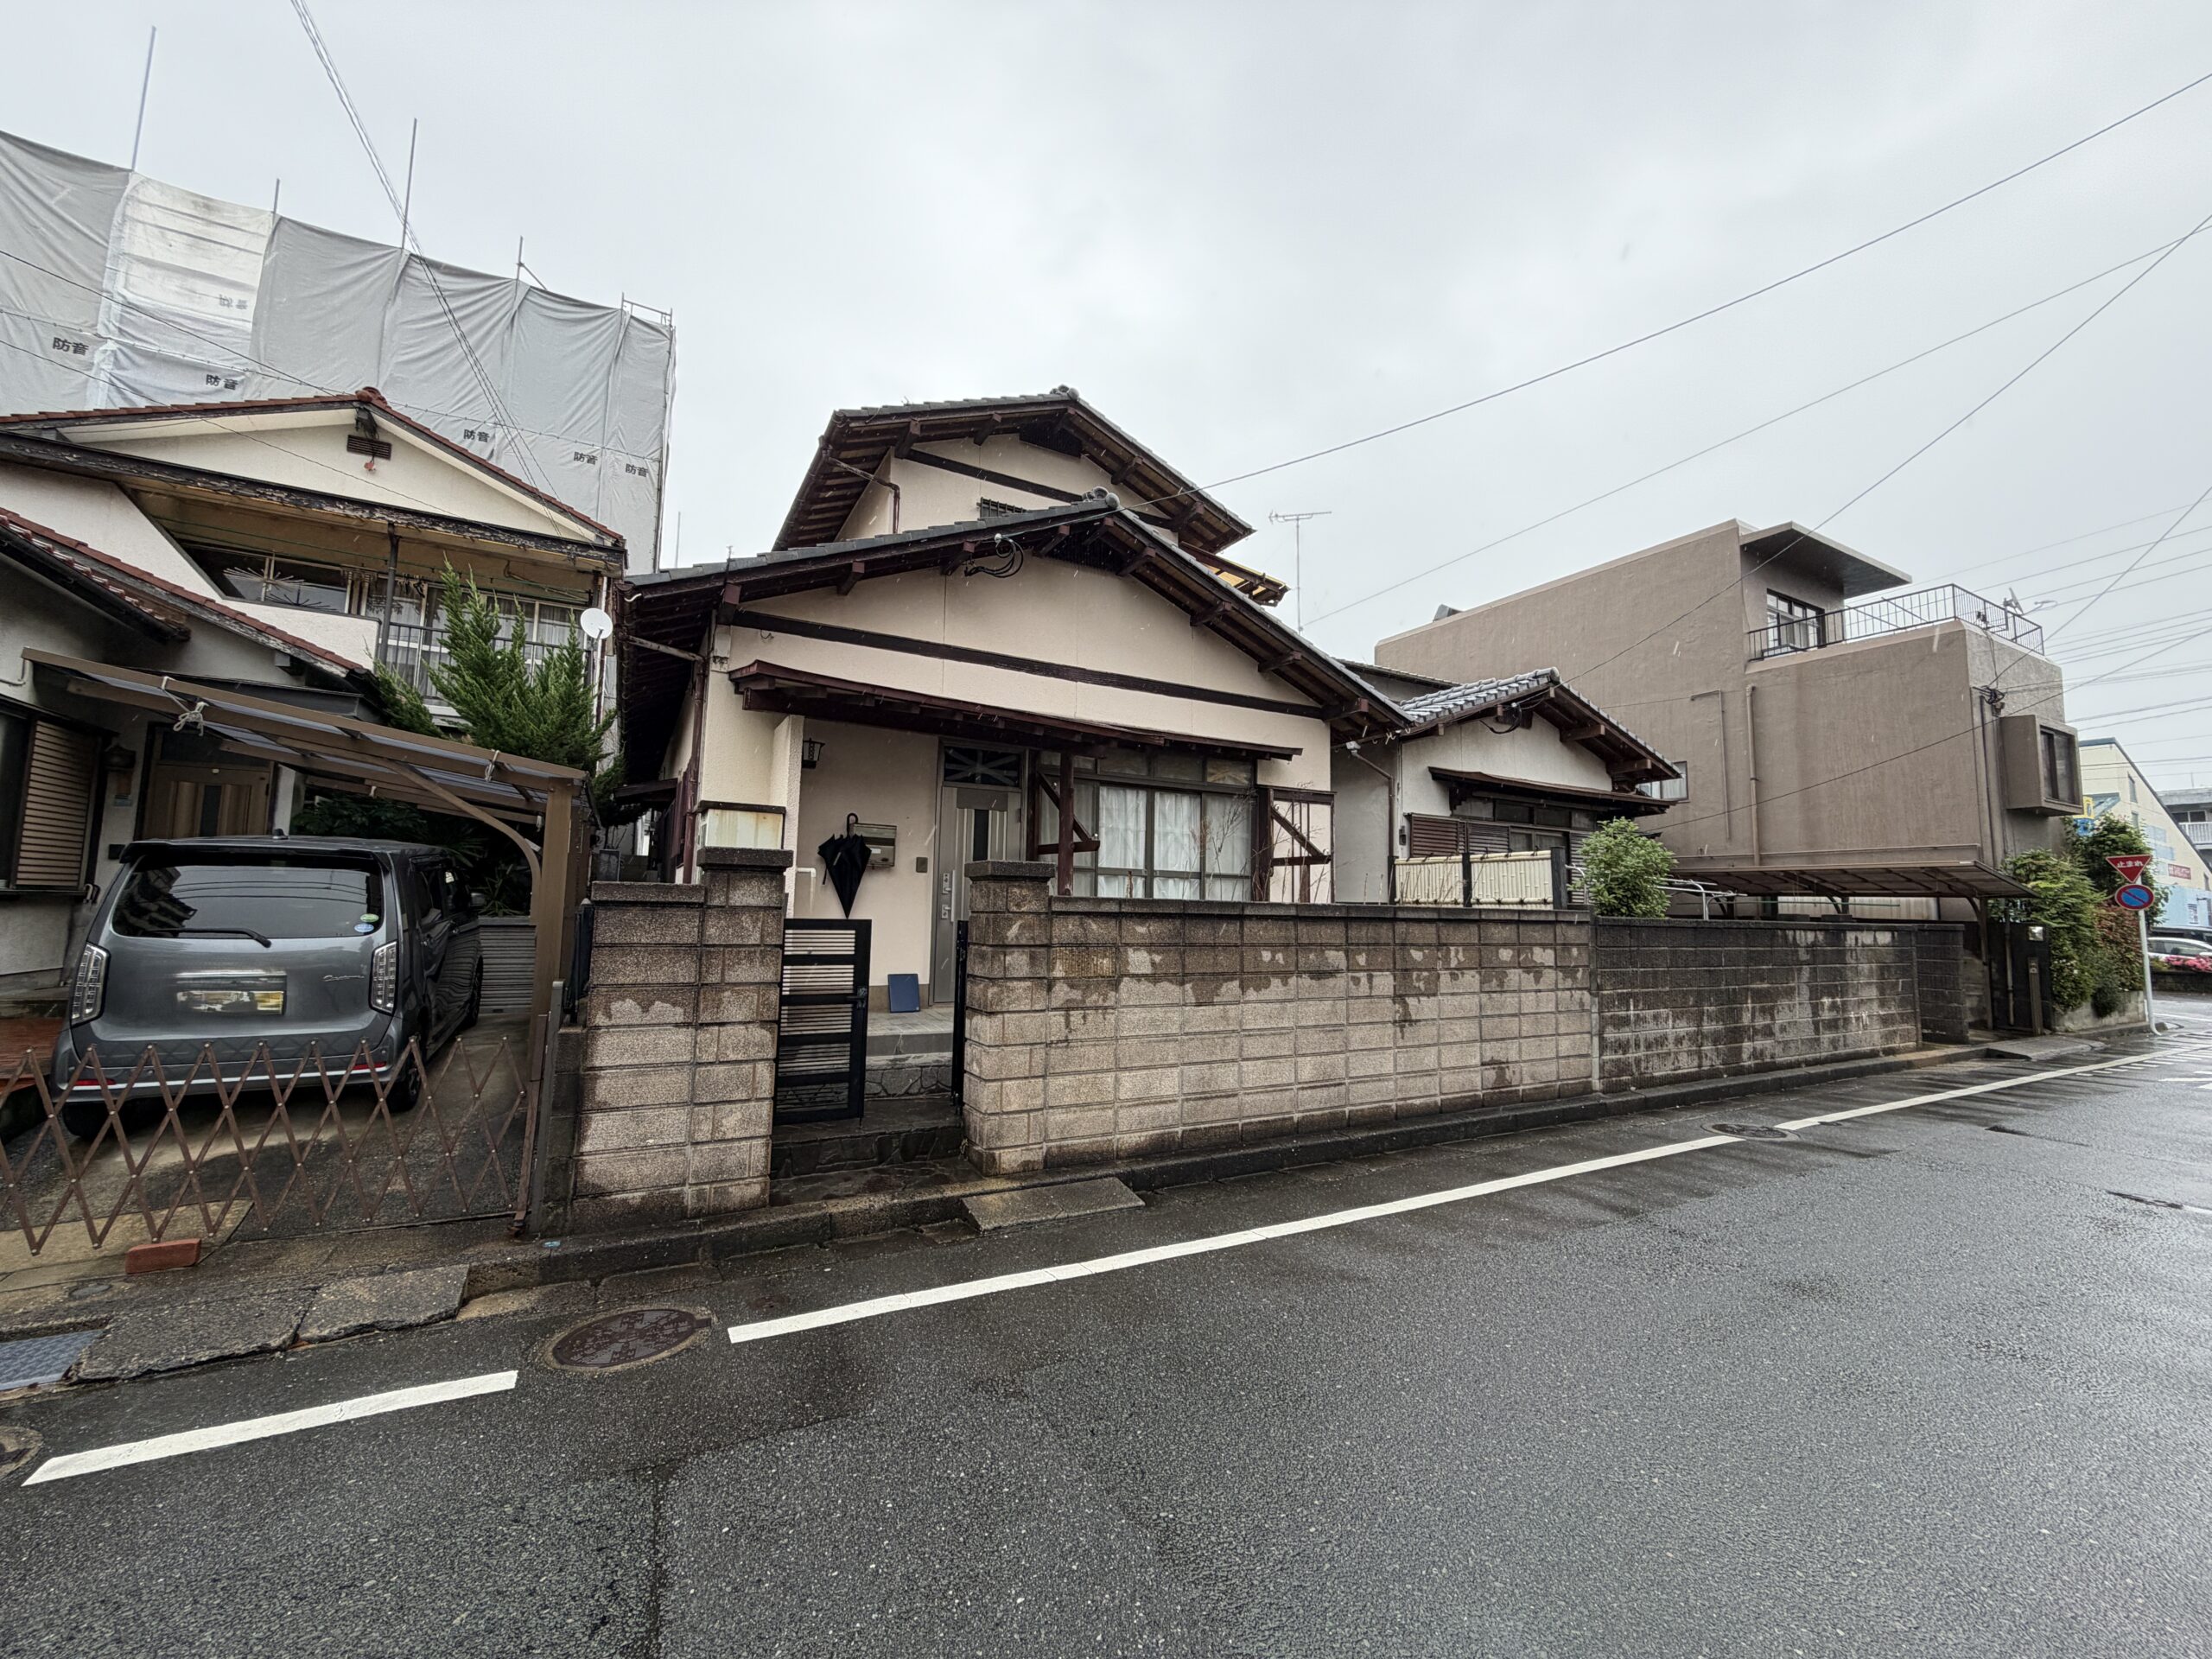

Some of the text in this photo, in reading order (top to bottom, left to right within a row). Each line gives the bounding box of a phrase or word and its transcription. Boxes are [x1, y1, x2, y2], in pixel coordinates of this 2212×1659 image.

[53, 337, 89, 356] 防音
[206, 373, 238, 391] 防音
[464, 429, 490, 443] 防音
[574, 452, 598, 466] 防音
[626, 463, 648, 477] 防音
